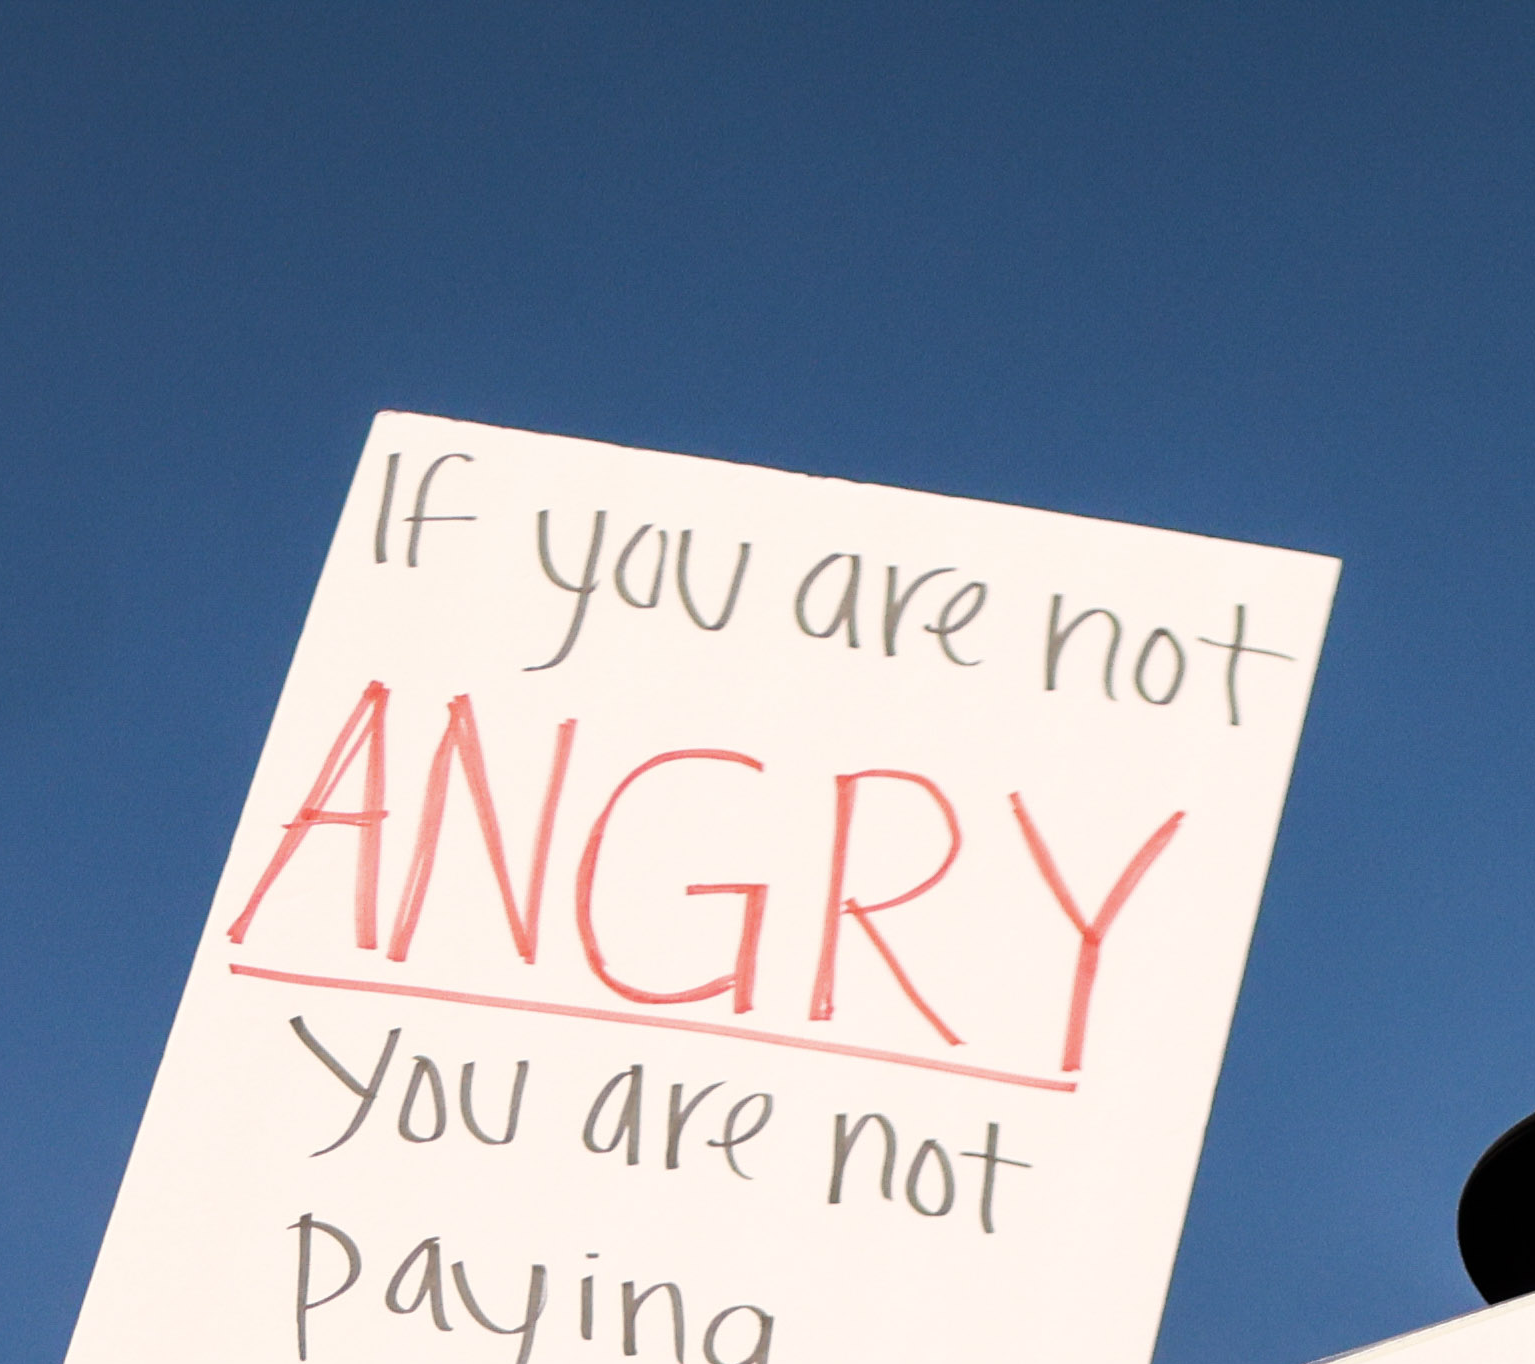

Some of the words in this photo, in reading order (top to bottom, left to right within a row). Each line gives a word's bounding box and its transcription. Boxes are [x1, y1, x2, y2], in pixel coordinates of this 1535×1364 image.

[523, 510, 751, 672] you
[795, 554, 988, 667] are
[1045, 595, 1296, 726] not
[226, 680, 1187, 1074] ANGRY
[582, 1064, 775, 1181] are
[828, 1113, 1034, 1235] not
